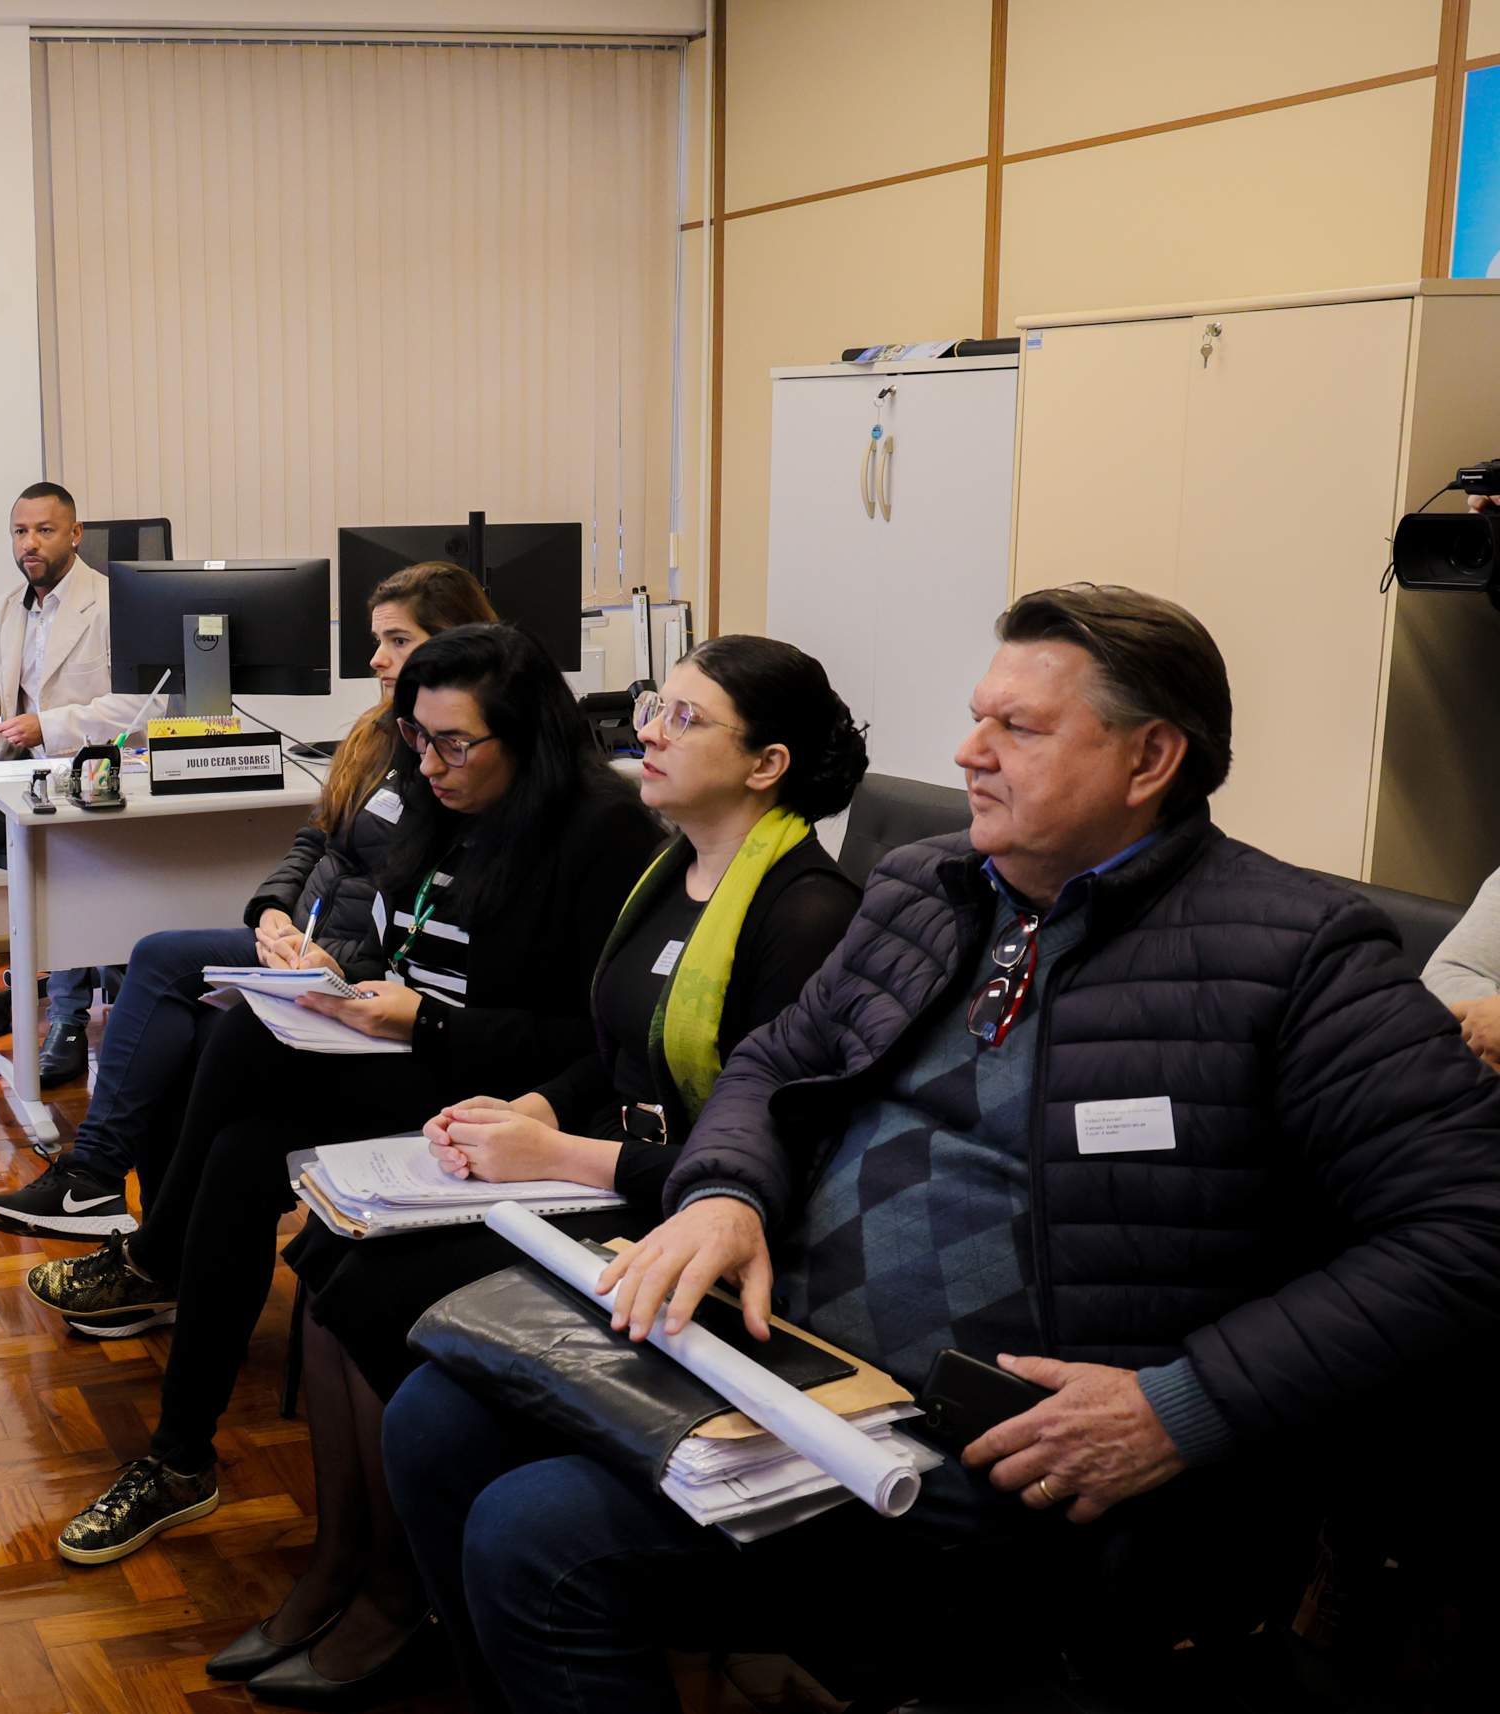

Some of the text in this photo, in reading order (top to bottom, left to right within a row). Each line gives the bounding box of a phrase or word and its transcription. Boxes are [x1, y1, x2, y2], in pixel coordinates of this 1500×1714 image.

[187, 755, 270, 768] JULIO CEZAR SOARES
